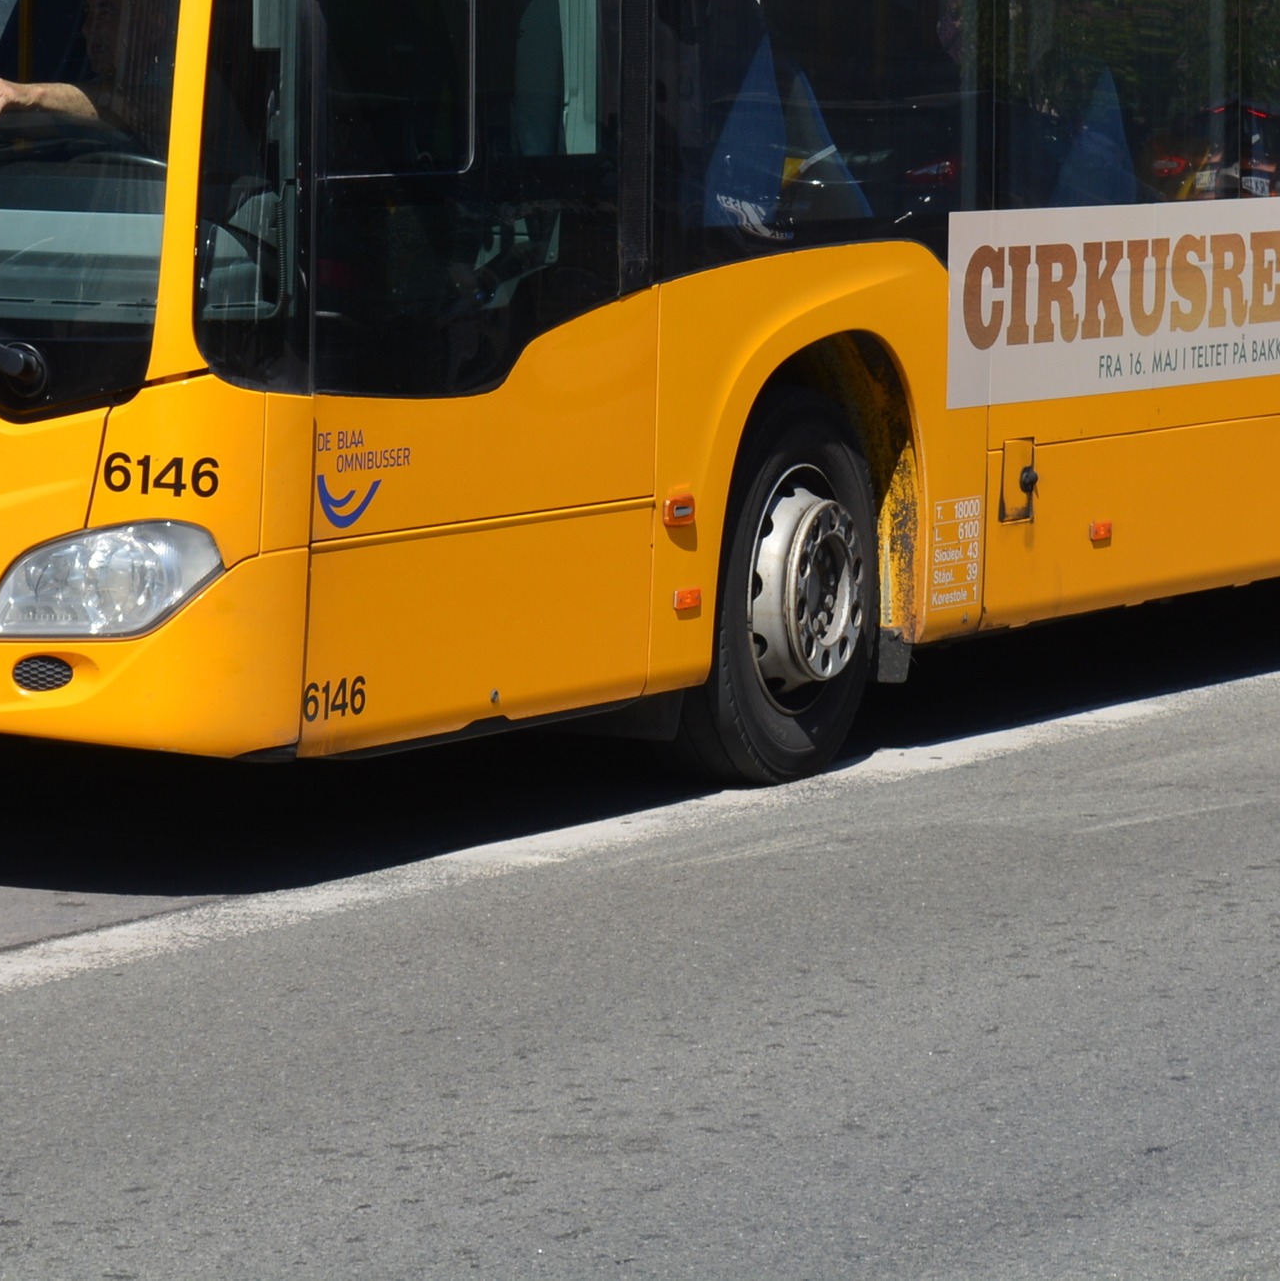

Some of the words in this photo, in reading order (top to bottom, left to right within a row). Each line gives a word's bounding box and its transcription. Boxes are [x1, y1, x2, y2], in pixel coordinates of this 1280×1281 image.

[1098, 354, 1123, 379] FRA
[1129, 351, 1146, 376] 16.
[1152, 348, 1178, 374] MAJ
[1182, 347, 1187, 370] I
[1191, 343, 1229, 369] TELTET
[1232, 333, 1247, 365] PÅ
[317, 432, 332, 452] DE
[337, 429, 365, 450] BLAA
[336, 447, 411, 473] OMNIBUSSER
[103, 452, 220, 498] 6146
[954, 499, 980, 519] 18000
[958, 520, 979, 540] 6100
[967, 541, 979, 559] 43
[966, 562, 978, 581] 39
[972, 584, 977, 600] 1
[302, 674, 367, 723] 6146
